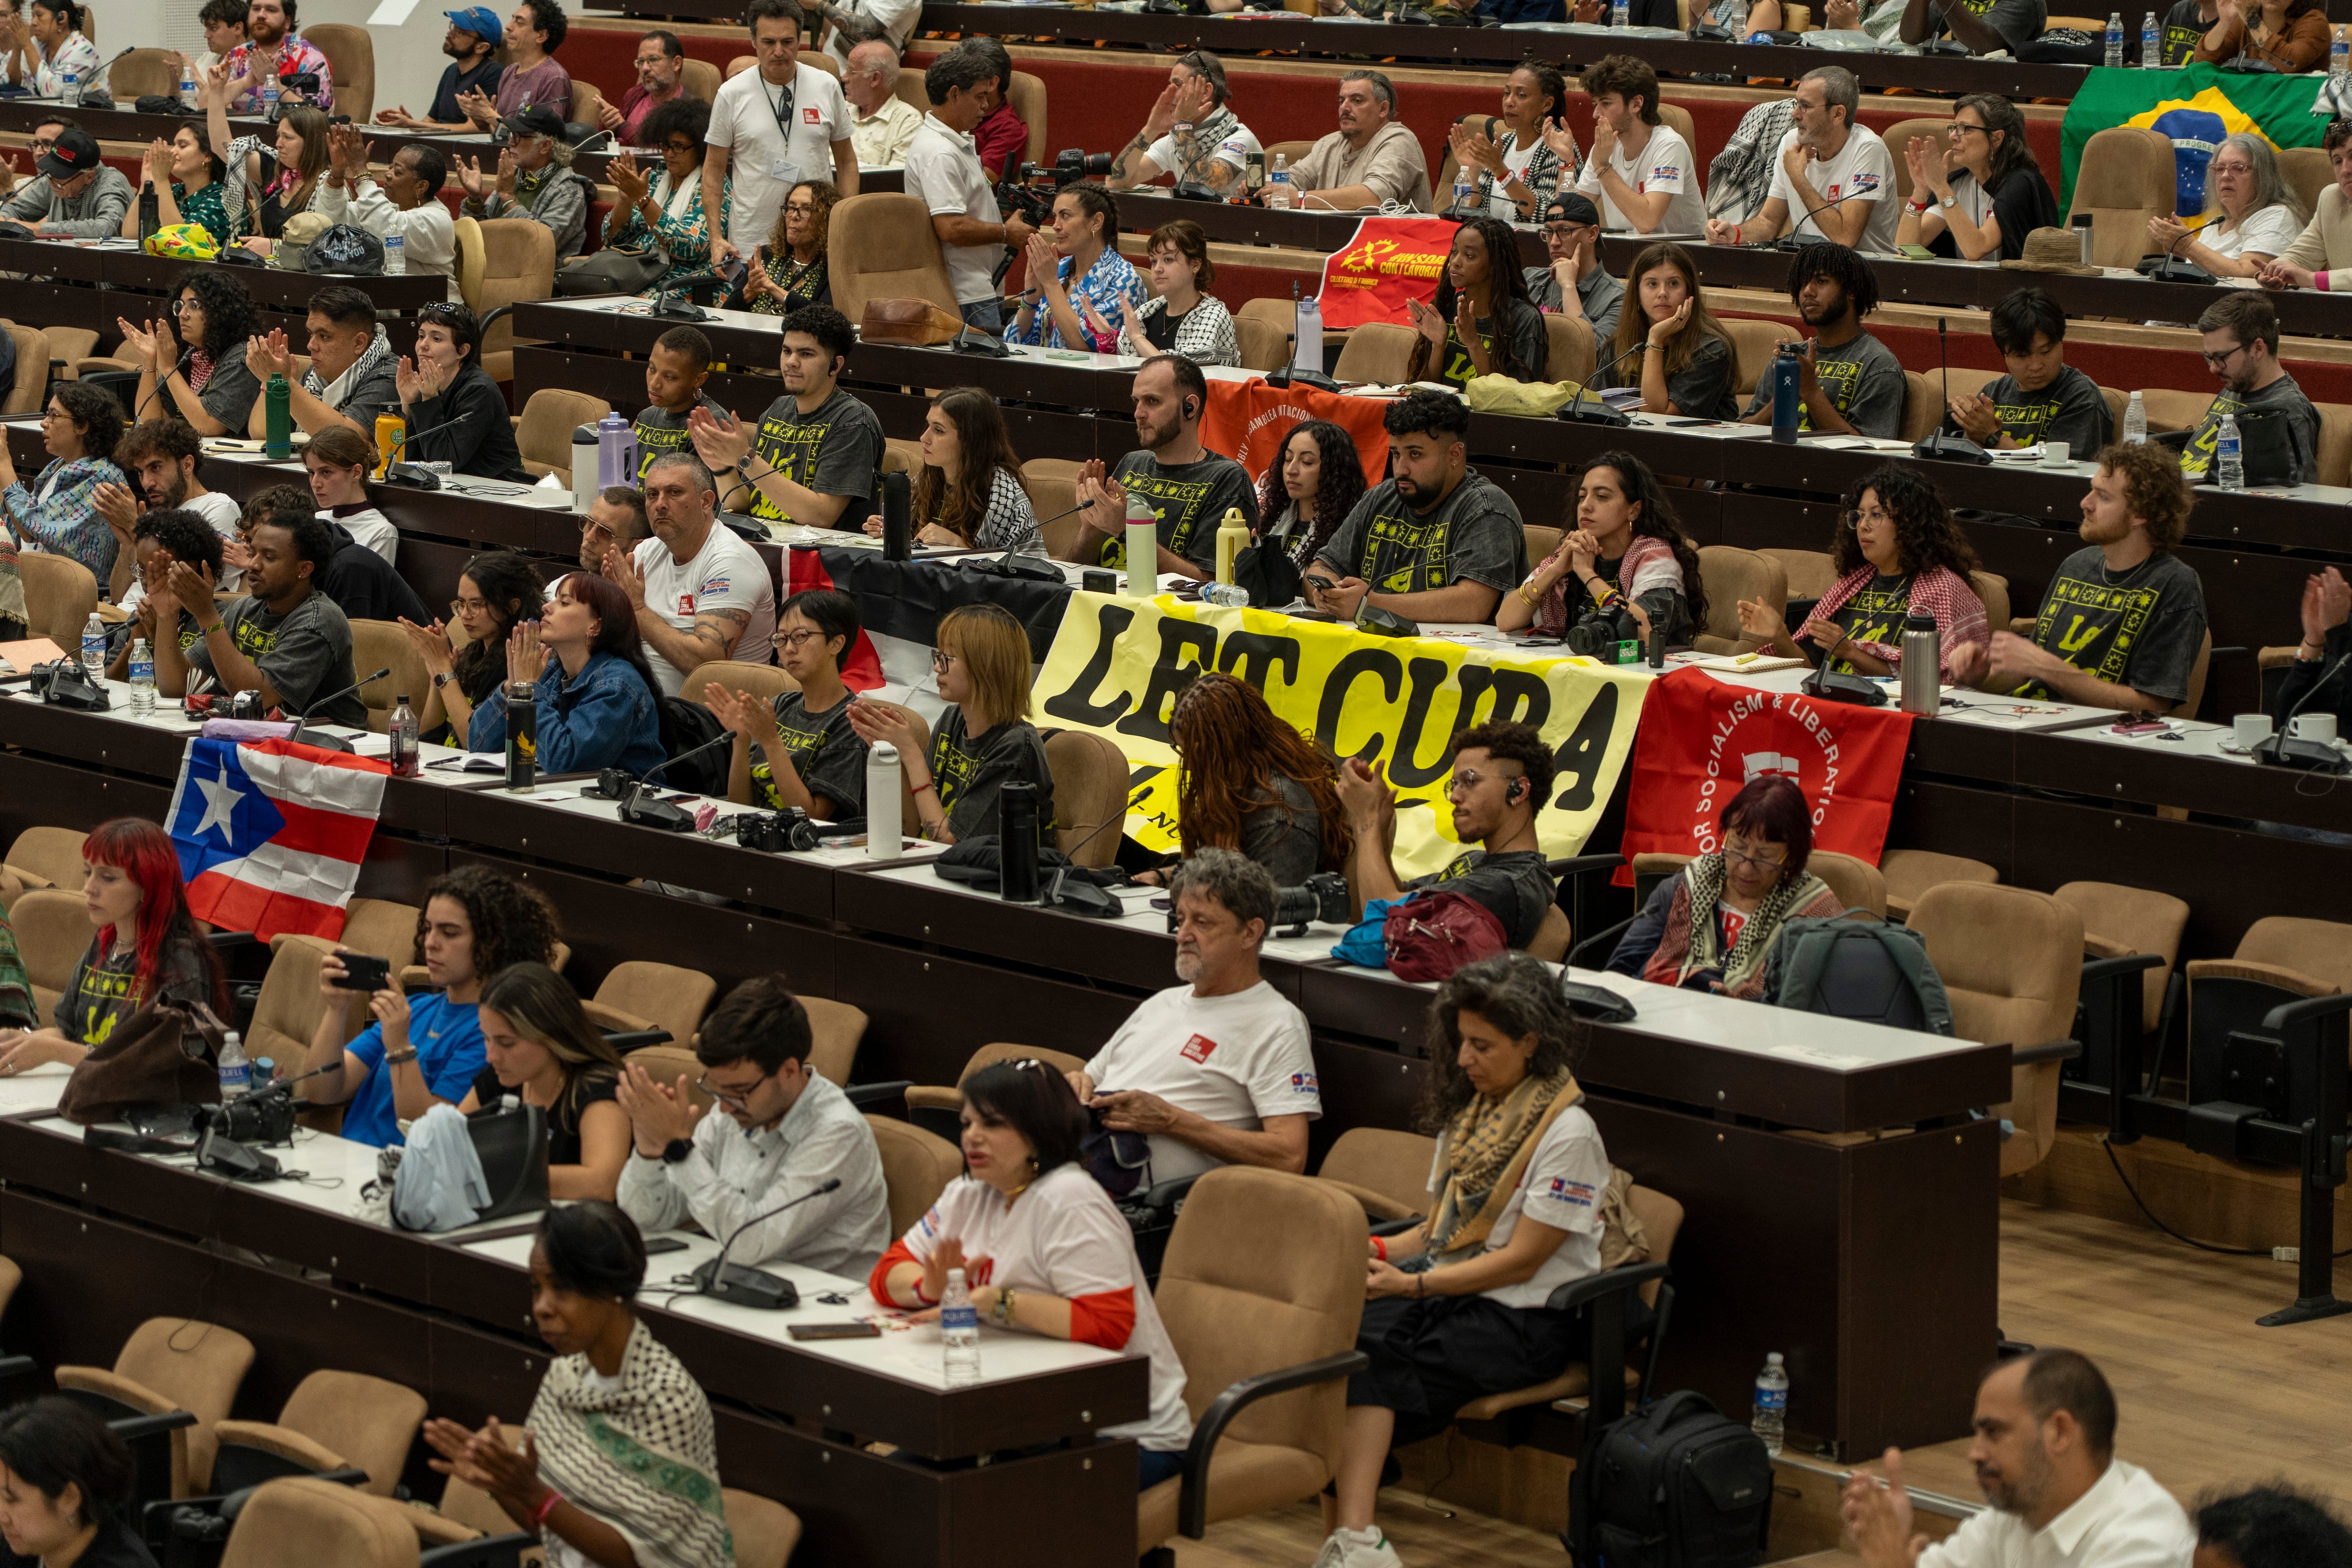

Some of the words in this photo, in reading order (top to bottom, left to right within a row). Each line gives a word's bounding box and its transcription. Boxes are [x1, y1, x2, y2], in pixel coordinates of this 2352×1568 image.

[325, 250, 348, 262] THANK
[348, 245, 365, 258] YOU
[1380, 262, 1398, 274] CON
[1043, 604, 1300, 745] LET
[1696, 692, 1764, 812] SOCIALISM
[1788, 698, 1839, 827] LIBERATIO
